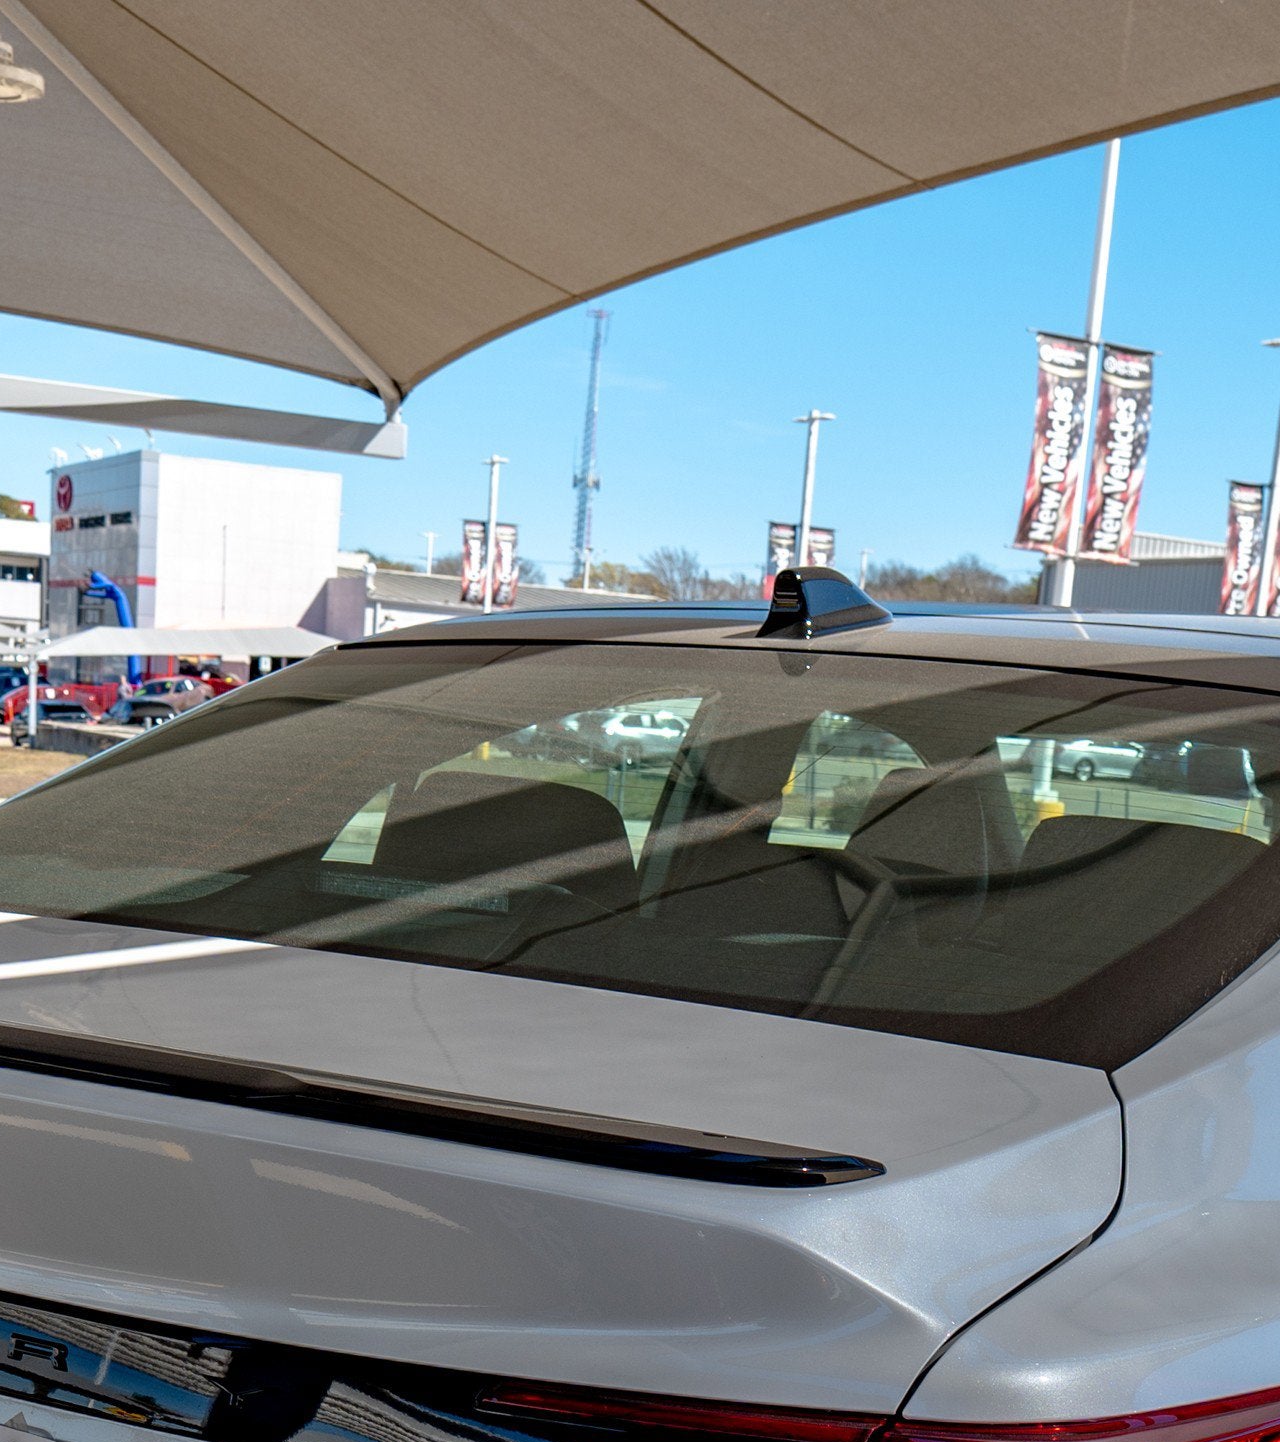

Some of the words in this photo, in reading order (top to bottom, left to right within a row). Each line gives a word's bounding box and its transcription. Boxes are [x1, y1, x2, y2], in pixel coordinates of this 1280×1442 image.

[1040, 385, 1074, 484] Vehicles
[1102, 397, 1138, 494] Vehicles
[1029, 485, 1063, 542] New
[1092, 496, 1125, 549] New
[1231, 515, 1255, 585] Owned
